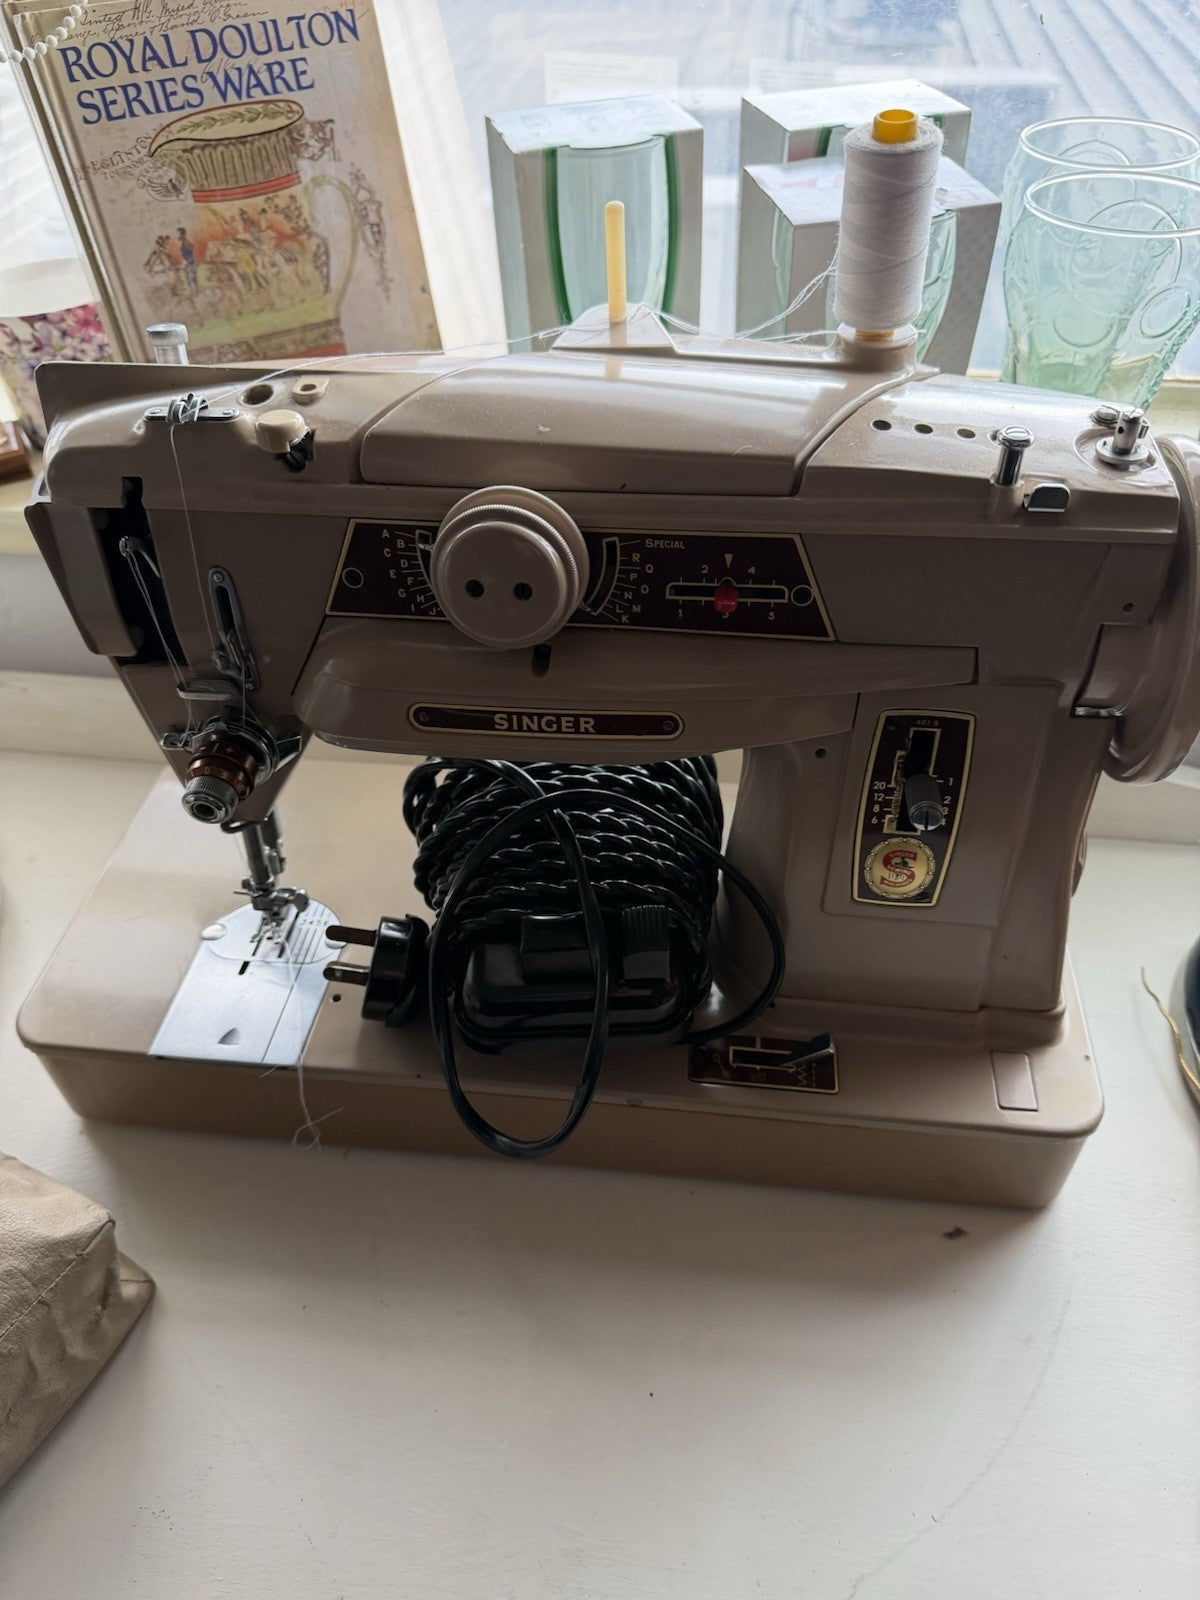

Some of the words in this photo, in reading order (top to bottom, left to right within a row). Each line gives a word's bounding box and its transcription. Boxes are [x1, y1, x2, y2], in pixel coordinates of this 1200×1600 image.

[56, 32, 189, 83] ROYAL
[187, 8, 360, 64] DOULTON
[77, 75, 204, 125] SERIES
[205, 57, 315, 103] WARE
[382, 529, 390, 538] A
[397, 539, 405, 548] B
[645, 538, 685, 549] SPECIAL
[384, 548, 391, 557] C
[632, 553, 640, 562] R
[401, 559, 408, 568] D
[645, 564, 654, 573] Q
[702, 565, 709, 573] 2
[749, 566, 757, 575] 4
[389, 570, 397, 578] E
[630, 573, 638, 581] P
[407, 577, 414, 585] F
[398, 589, 406, 597] G
[640, 584, 649, 594] O
[417, 594, 424, 603] H
[624, 591, 632, 599] N
[430, 607, 436, 615] J
[616, 604, 623, 613] L
[632, 604, 641, 612] M
[622, 615, 629, 623] K
[678, 609, 683, 617] 1
[769, 612, 775, 620] 5
[494, 713, 596, 733] SINGER
[873, 782, 886, 790] 20
[874, 793, 884, 801] 12
[944, 796, 952, 804] 2
[873, 804, 880, 812] 8
[871, 816, 878, 824] 6
